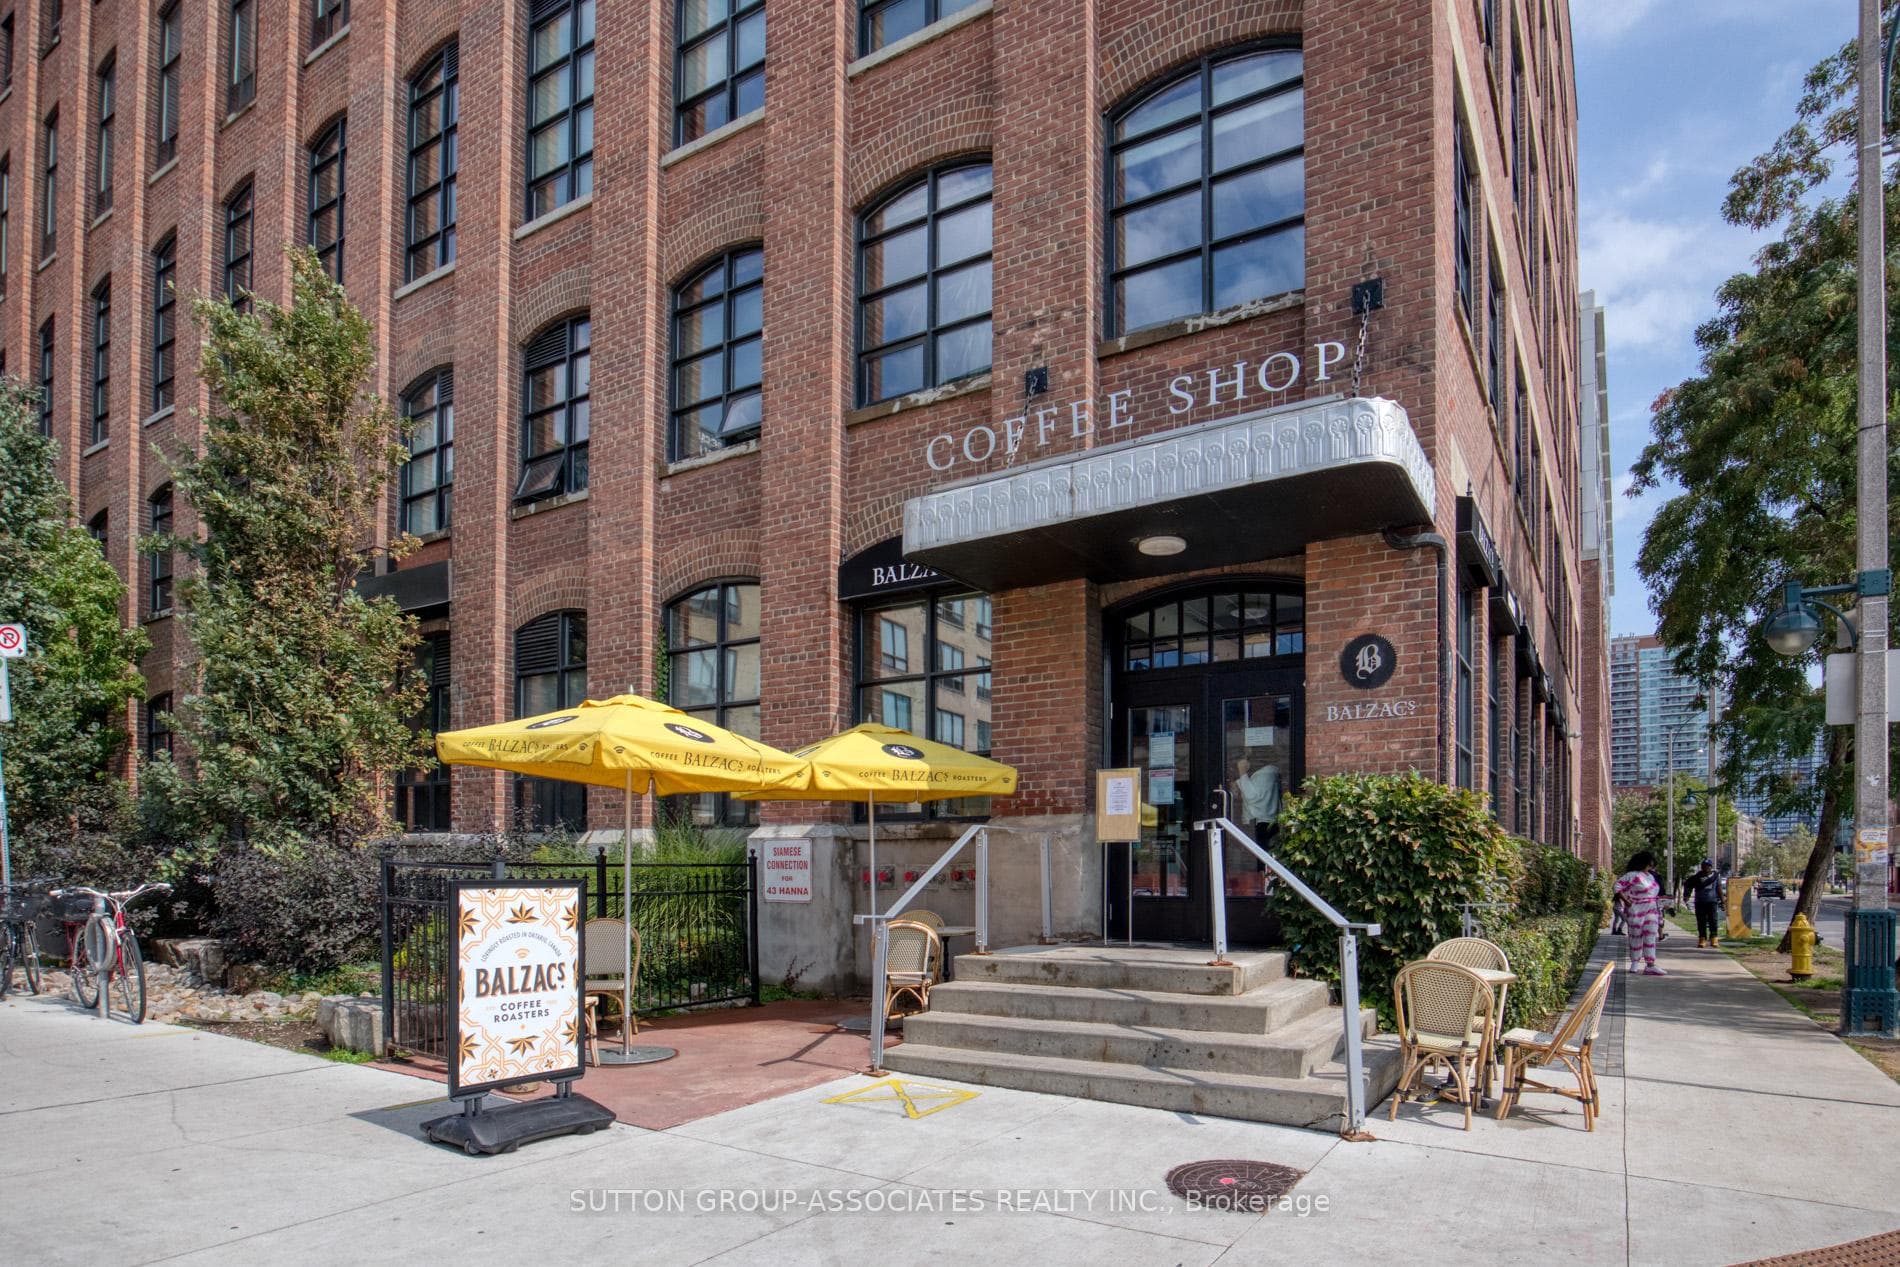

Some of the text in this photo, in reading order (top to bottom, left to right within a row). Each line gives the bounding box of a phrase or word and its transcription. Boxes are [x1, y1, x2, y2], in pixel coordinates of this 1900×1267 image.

[926, 340, 1346, 471] COFFEE SHOP
[952, 774, 989, 783] ROASTERS
[772, 846, 802, 857] SIAMESE
[766, 860, 809, 870] CONNECTION
[767, 886, 809, 896] 43 HANNA
[500, 999, 542, 1012] COFFEE
[493, 1008, 550, 1023] ROASTERS
